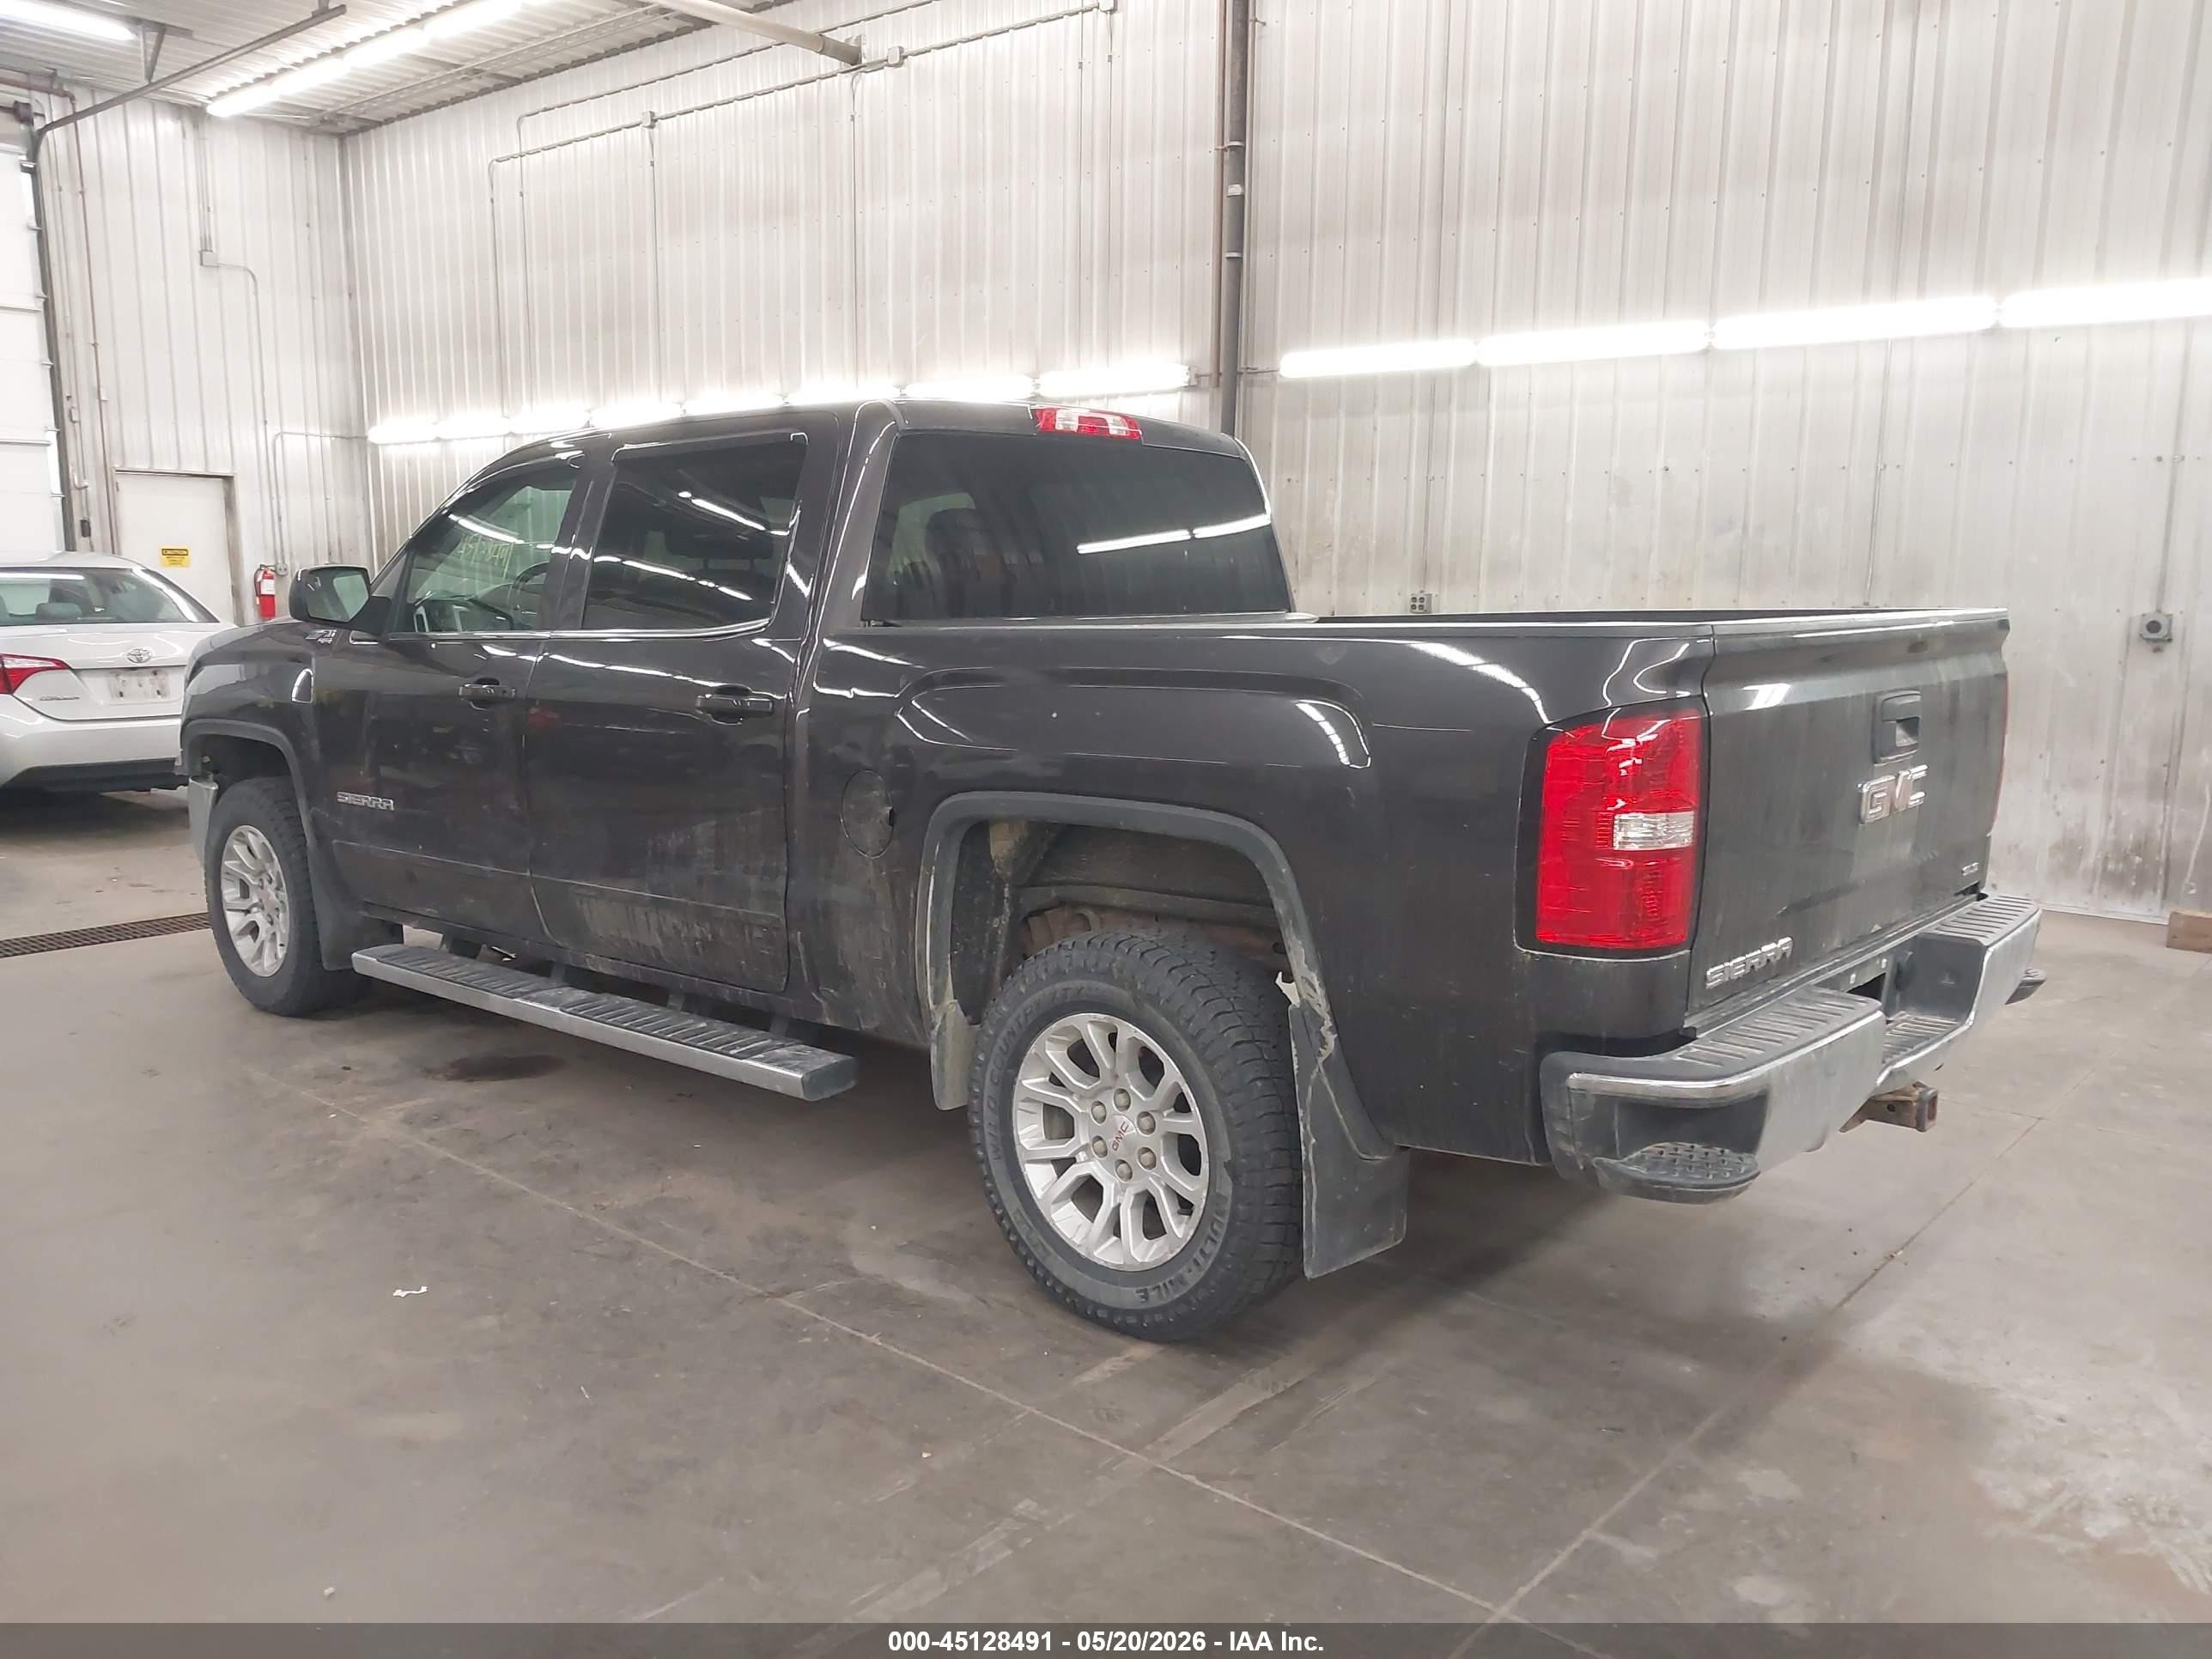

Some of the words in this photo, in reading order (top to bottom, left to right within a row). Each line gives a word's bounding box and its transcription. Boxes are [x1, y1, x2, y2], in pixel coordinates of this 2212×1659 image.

[336, 791, 395, 811] SIERRA
[1856, 763, 1929, 825] GMC
[1705, 936, 1794, 990] SIERRA
[1111, 1121, 1130, 1152] GMC
